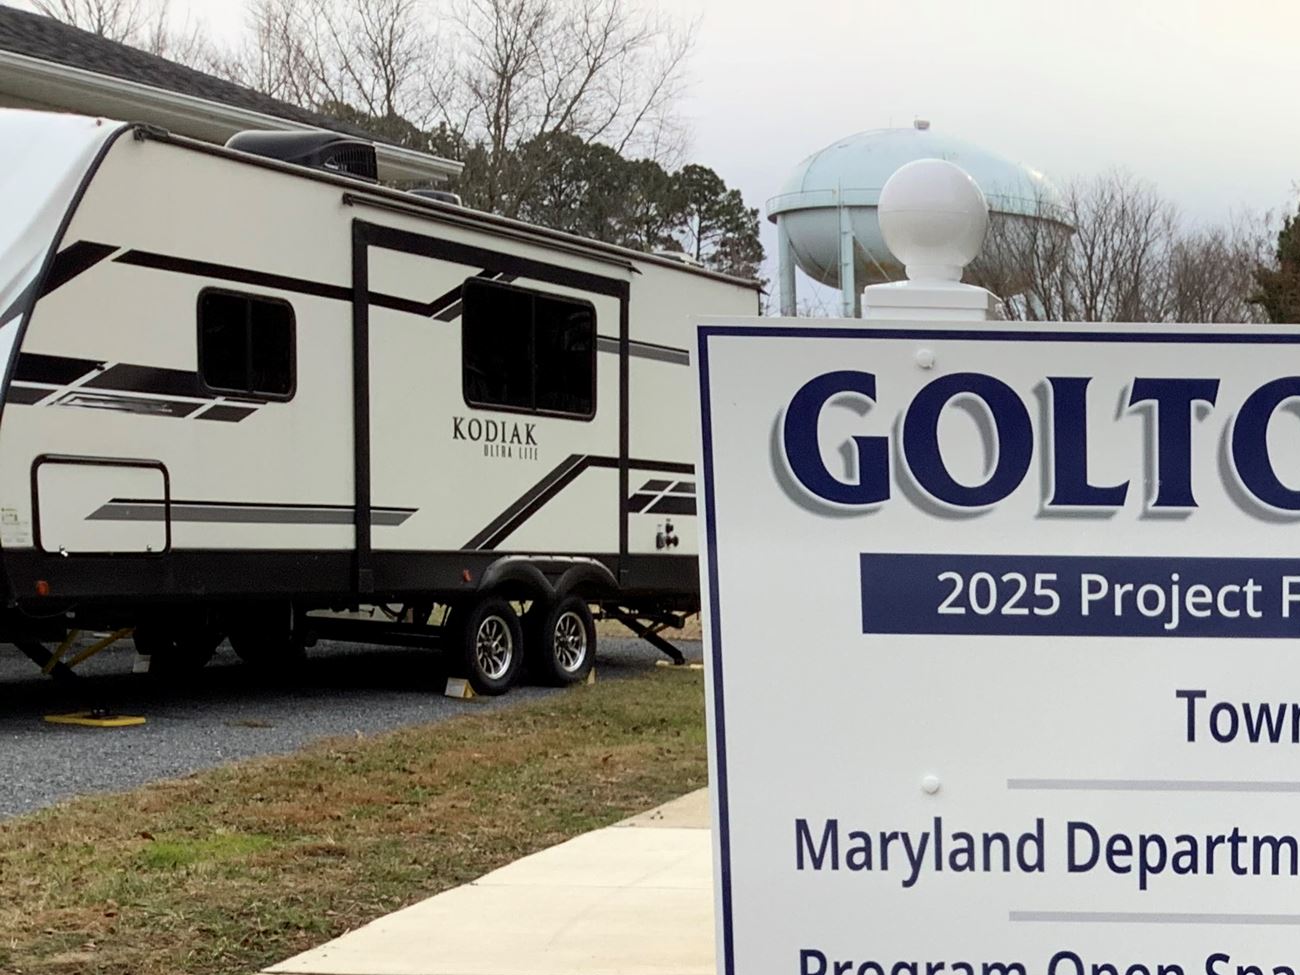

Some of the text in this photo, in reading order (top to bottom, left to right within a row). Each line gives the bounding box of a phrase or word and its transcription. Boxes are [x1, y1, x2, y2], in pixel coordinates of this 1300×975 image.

[452, 416, 538, 445] KODIAK
[484, 444, 538, 460] ULTRA LITE
[937, 573, 1060, 619] 2025
[1080, 572, 1262, 631] Project
[796, 817, 1045, 887] Maryland
